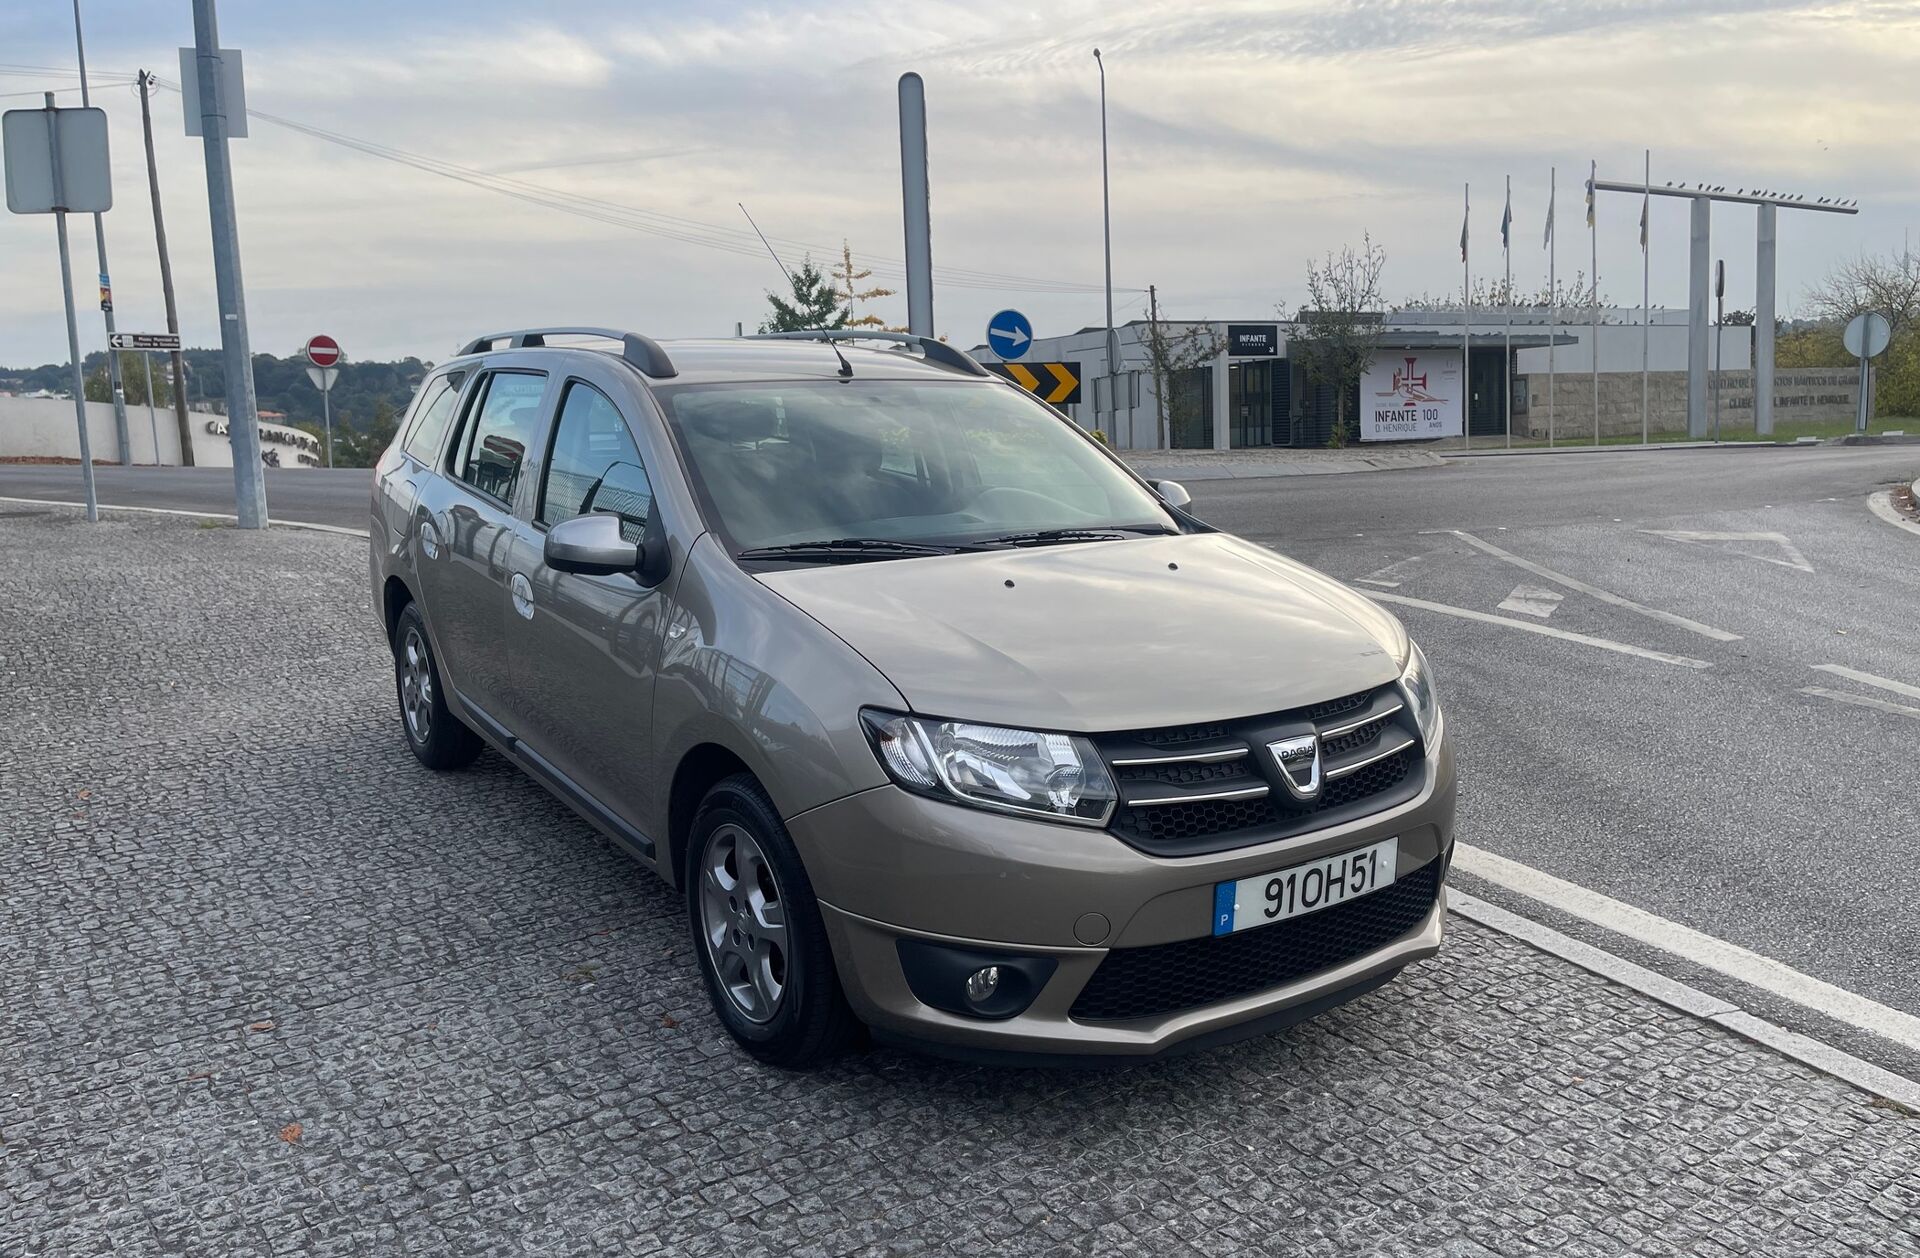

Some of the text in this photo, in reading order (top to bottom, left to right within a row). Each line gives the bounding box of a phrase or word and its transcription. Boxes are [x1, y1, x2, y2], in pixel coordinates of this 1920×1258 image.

[1239, 334, 1267, 343] INFANTE
[1375, 409, 1417, 423] INFANTE
[1422, 408, 1438, 421] 100
[1383, 422, 1417, 433] HENRIQUE
[1428, 421, 1443, 429] ANOS
[1281, 745, 1314, 759] DACIA
[1220, 914, 1229, 926] P
